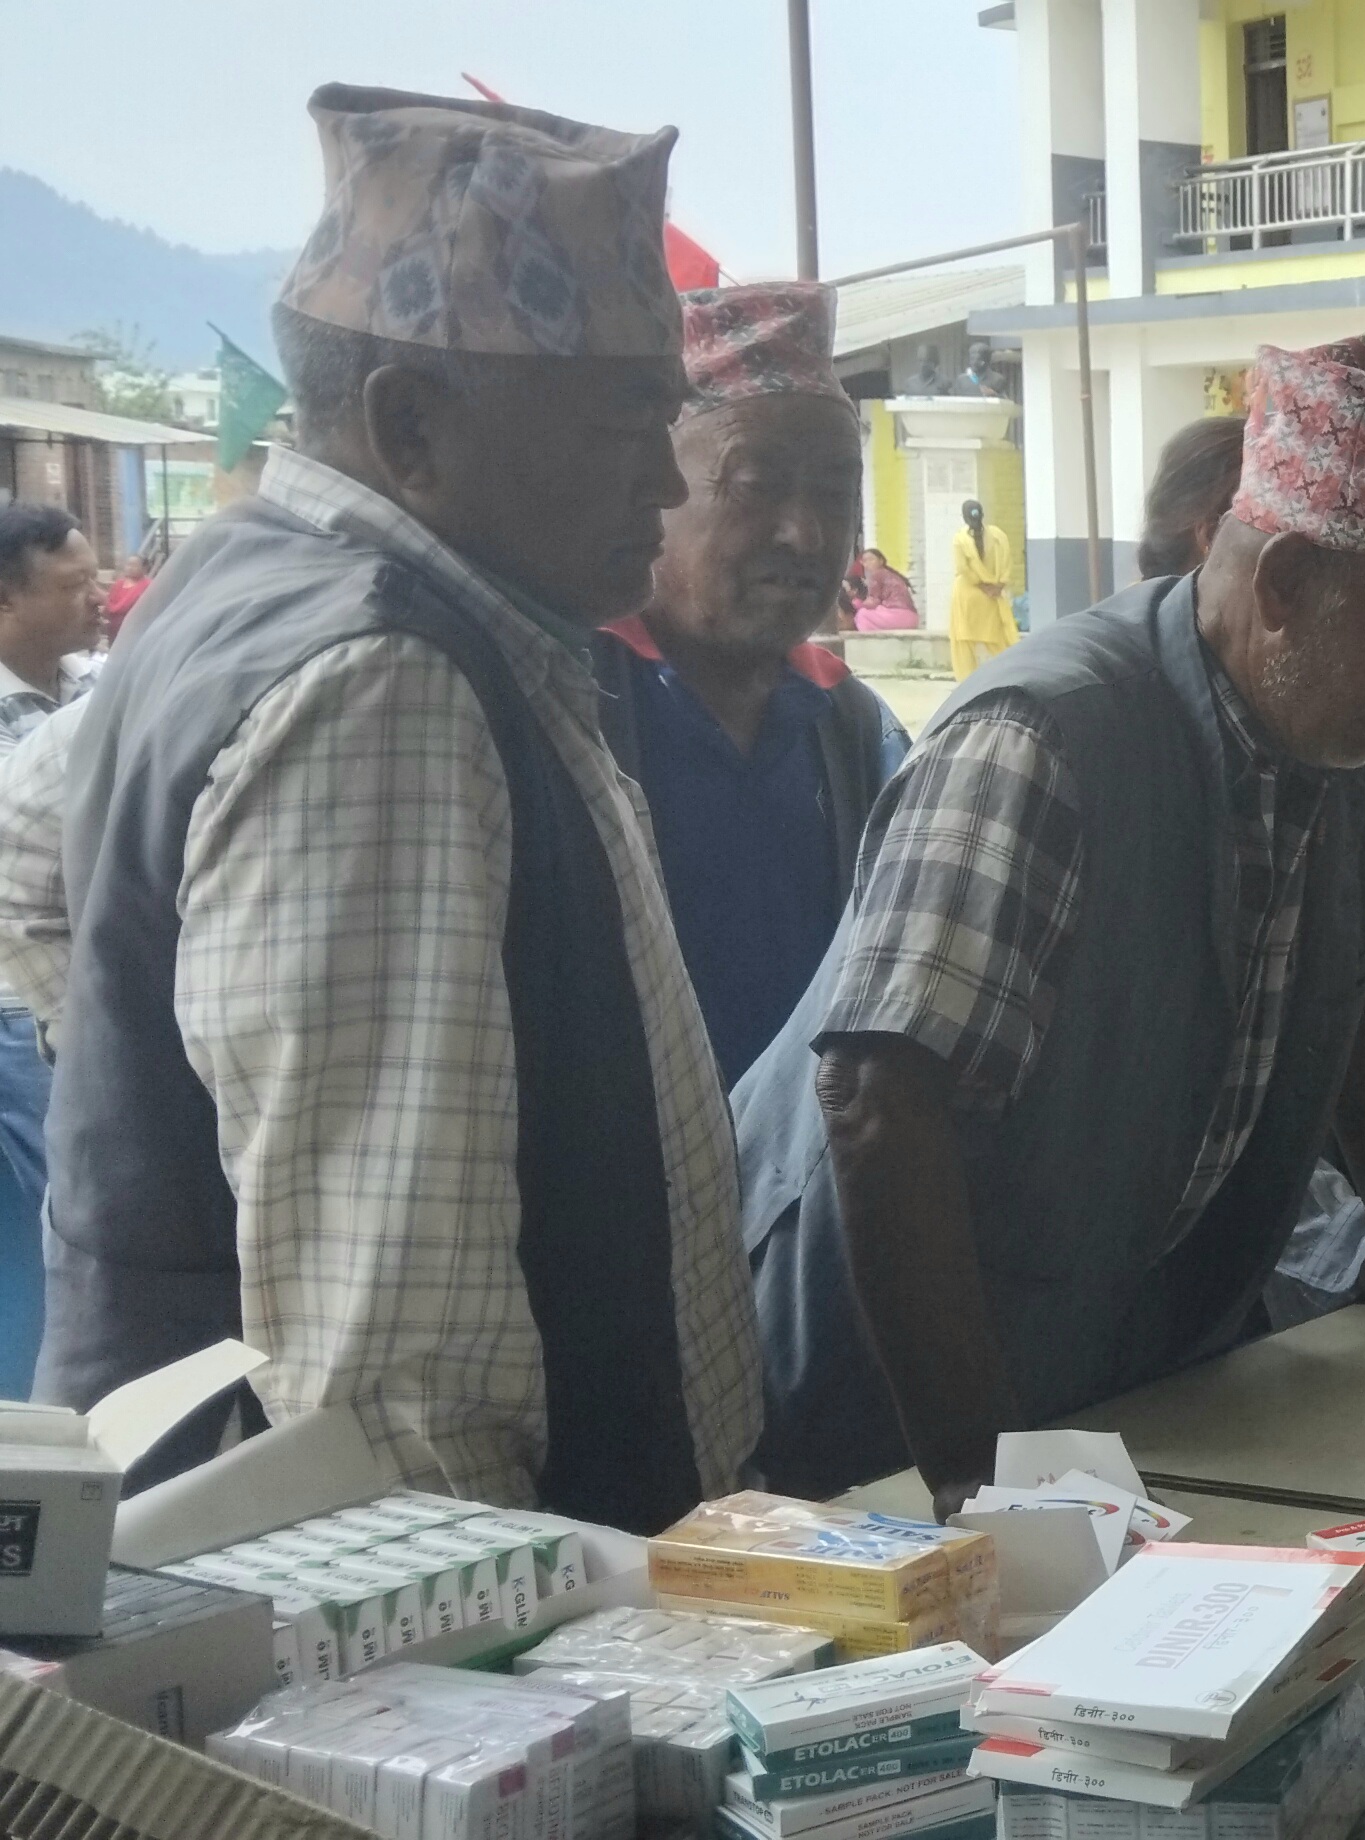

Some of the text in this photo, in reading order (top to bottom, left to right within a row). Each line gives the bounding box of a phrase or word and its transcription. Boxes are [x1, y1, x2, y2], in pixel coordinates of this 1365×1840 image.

[561, 1563, 575, 1592] K-G
[1135, 1582, 1250, 1669] DINIR-300
[874, 1654, 974, 1683] ETOLAC
[1073, 1704, 1135, 1722] डिनीर-३००
[1051, 1768, 1105, 1788] डिनीर-३००
[825, 1797, 862, 1815] SAMPLE
[897, 1784, 915, 1794] NOT
[917, 1777, 937, 1790] FOR
[939, 1771, 962, 1784] SALE
[857, 1810, 912, 1831] SAMPLE PACK
[858, 1817, 914, 1839] NOT FOR SALE
